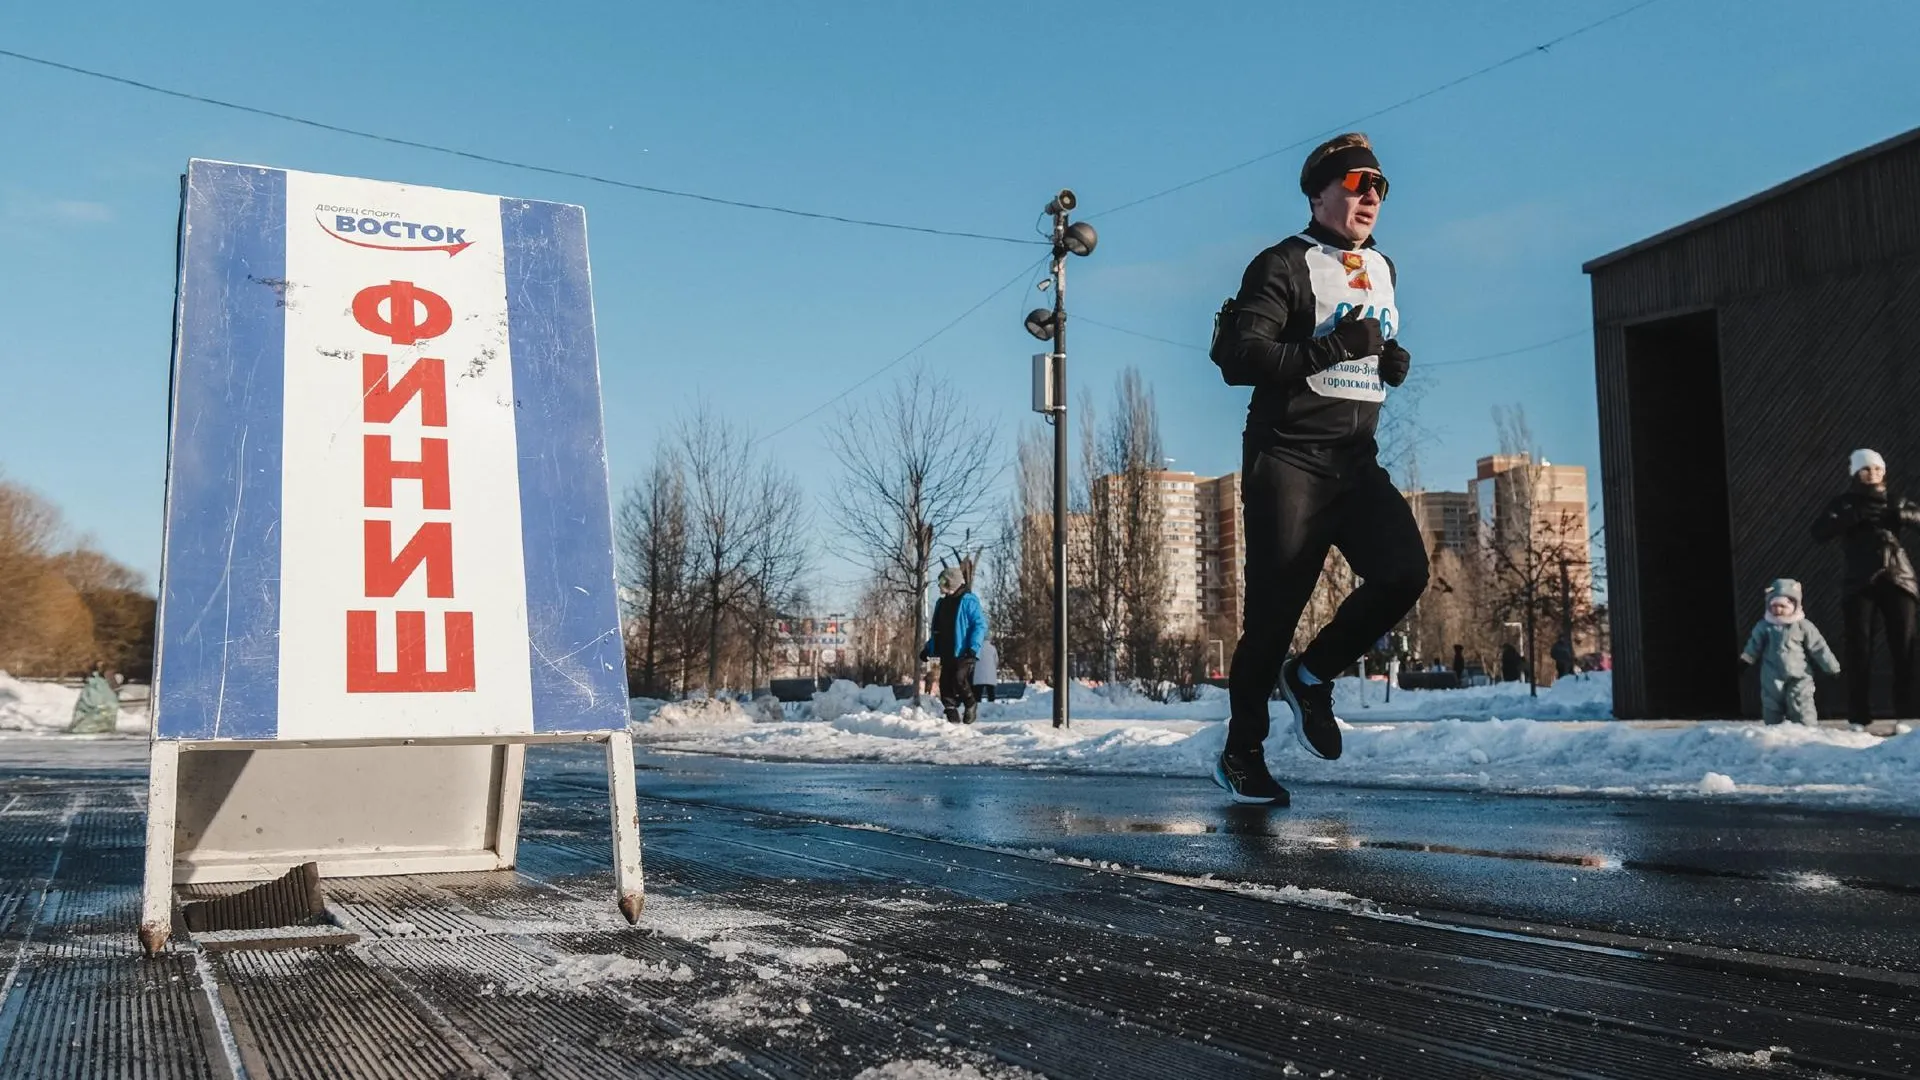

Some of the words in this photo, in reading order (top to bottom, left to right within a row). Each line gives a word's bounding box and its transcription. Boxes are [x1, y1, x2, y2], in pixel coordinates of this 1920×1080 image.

[315, 203, 358, 215] ДВОРЕЦ
[360, 208, 401, 219] СПОРТА
[335, 214, 467, 244] ВОСТОК
[347, 280, 476, 693] ФИНИШ
